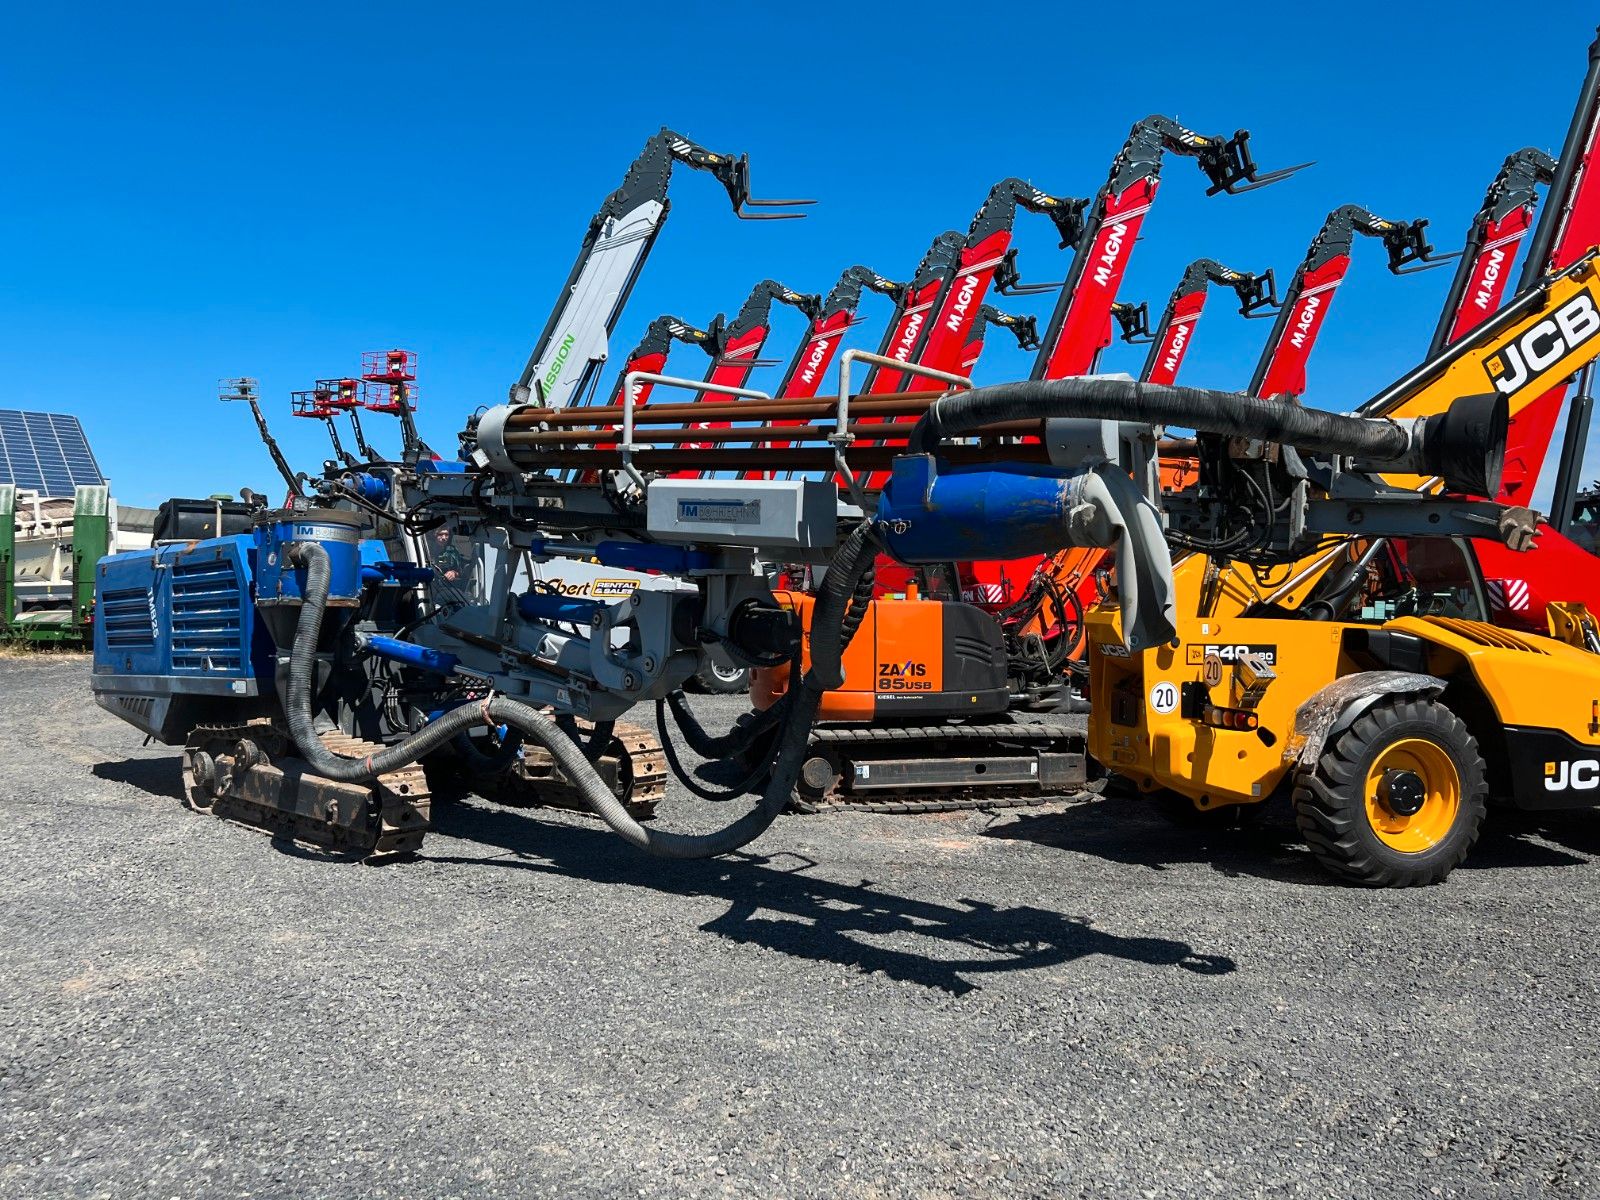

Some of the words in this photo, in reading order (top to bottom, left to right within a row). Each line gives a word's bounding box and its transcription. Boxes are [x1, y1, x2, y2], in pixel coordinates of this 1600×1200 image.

[1093, 223, 1128, 287] MAGNI
[946, 275, 980, 332] MAGNI
[1474, 249, 1505, 310] MAGNI
[895, 313, 924, 362] MAGNI
[1290, 296, 1321, 349] MAGNI
[1495, 295, 1600, 394] JCB
[801, 340, 830, 384] MAGNI
[1163, 324, 1190, 372] MAGNI
[879, 661, 926, 676] ZAXIS
[1101, 644, 1129, 658] JCB
[1207, 660, 1219, 681] 20
[1156, 688, 1174, 708] 20
